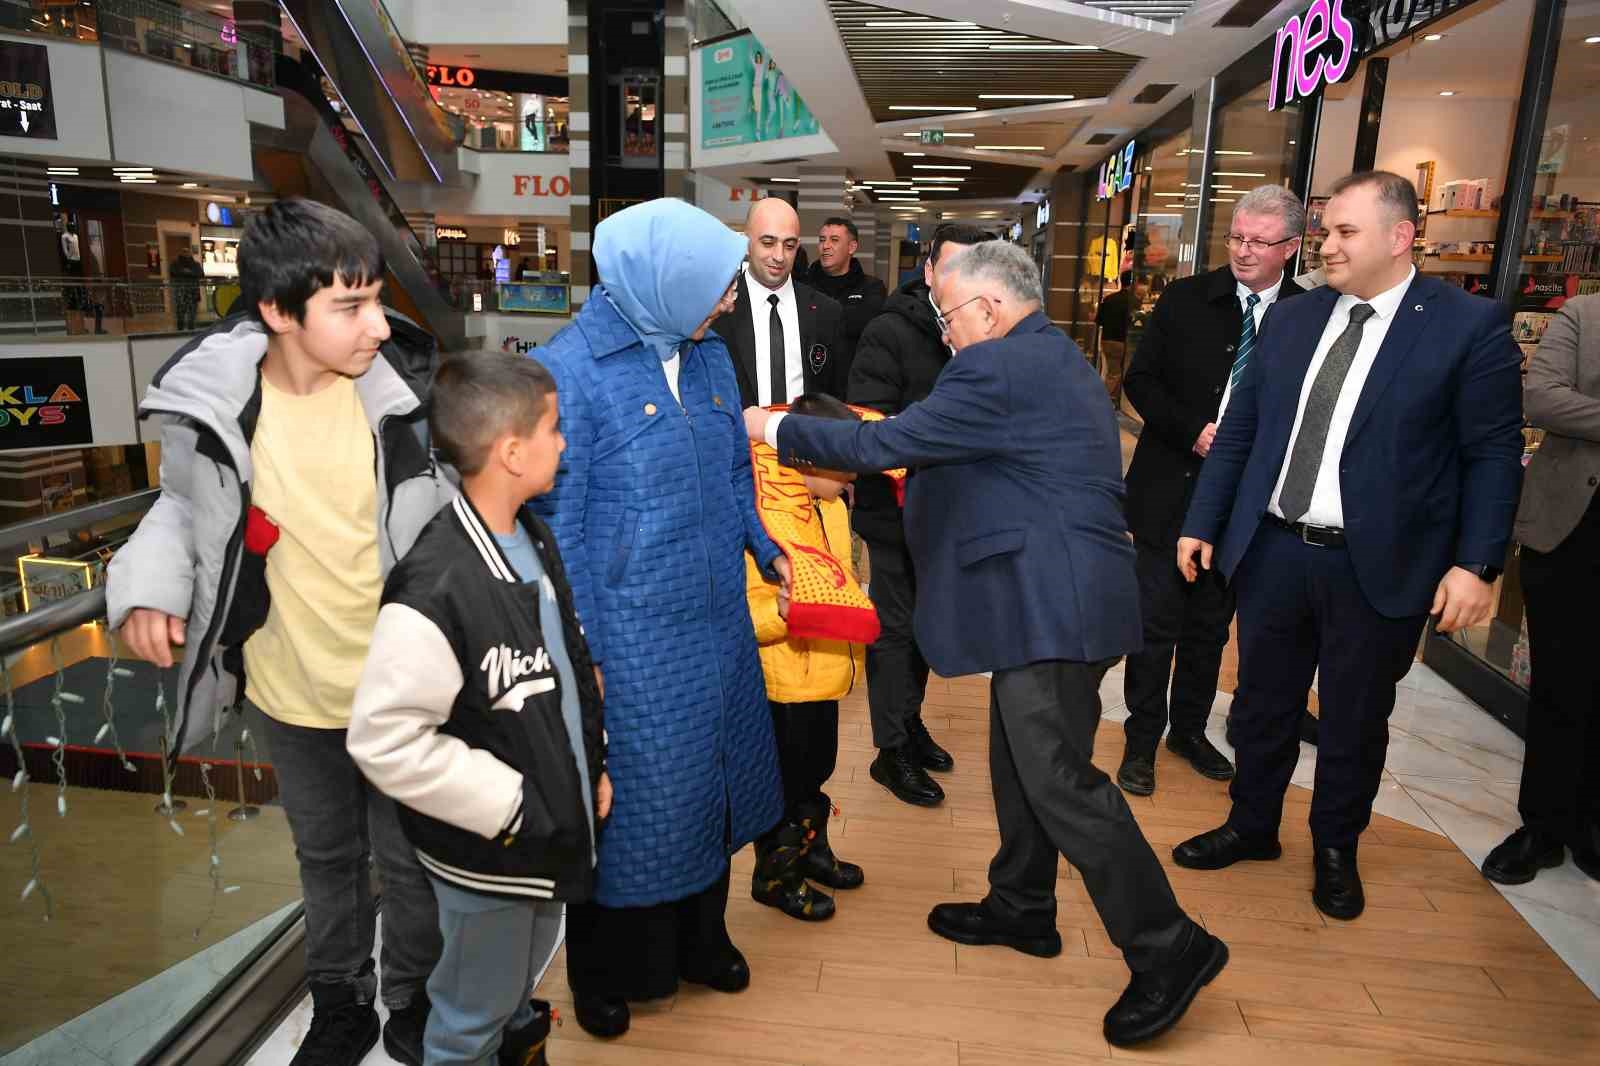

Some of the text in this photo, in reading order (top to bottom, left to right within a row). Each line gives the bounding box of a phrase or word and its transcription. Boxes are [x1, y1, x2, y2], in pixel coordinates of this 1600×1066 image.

[1268, 0, 1354, 112] nes
[19, 100, 42, 112] Saat
[512, 175, 570, 198] FLO
